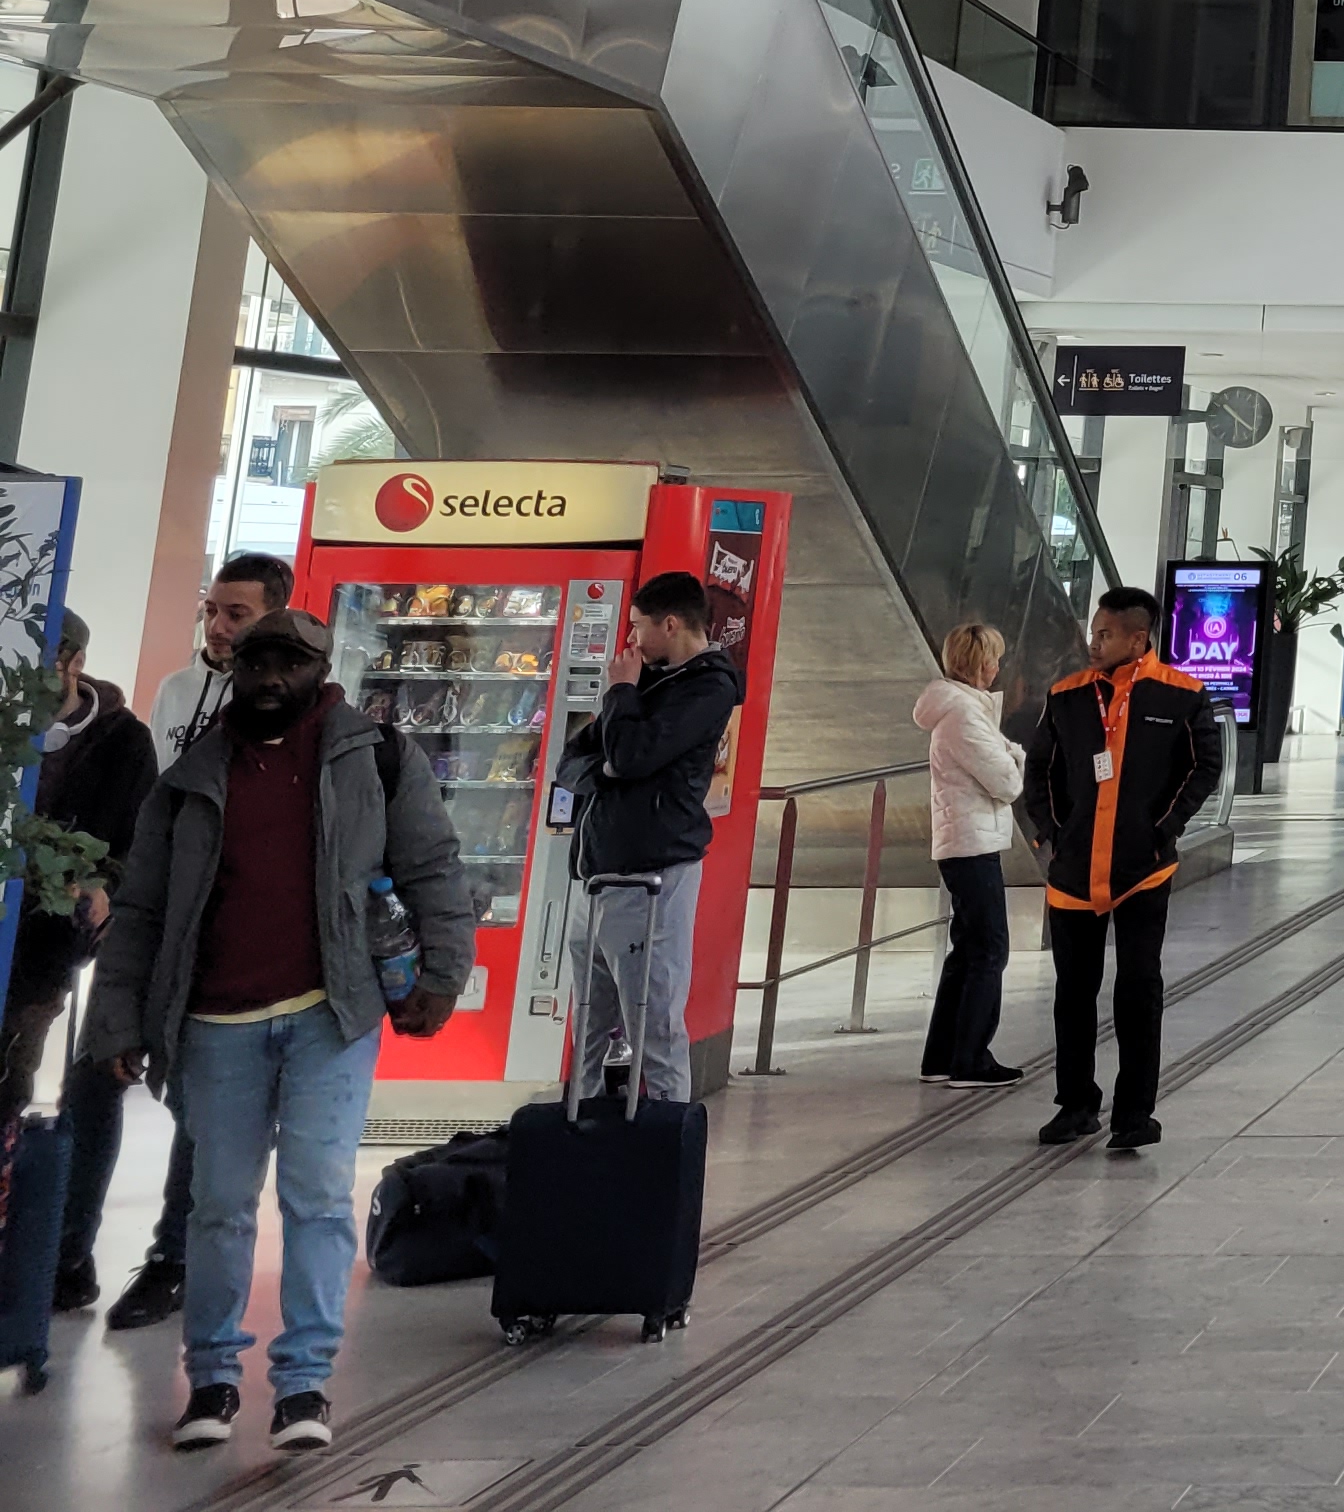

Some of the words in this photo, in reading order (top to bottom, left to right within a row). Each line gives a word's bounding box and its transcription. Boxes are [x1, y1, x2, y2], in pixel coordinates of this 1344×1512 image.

[1129, 374, 1172, 384] Toilettes
[439, 489, 567, 517] selecta
[1233, 573, 1248, 581] 06
[1190, 642, 1238, 660] DAY
